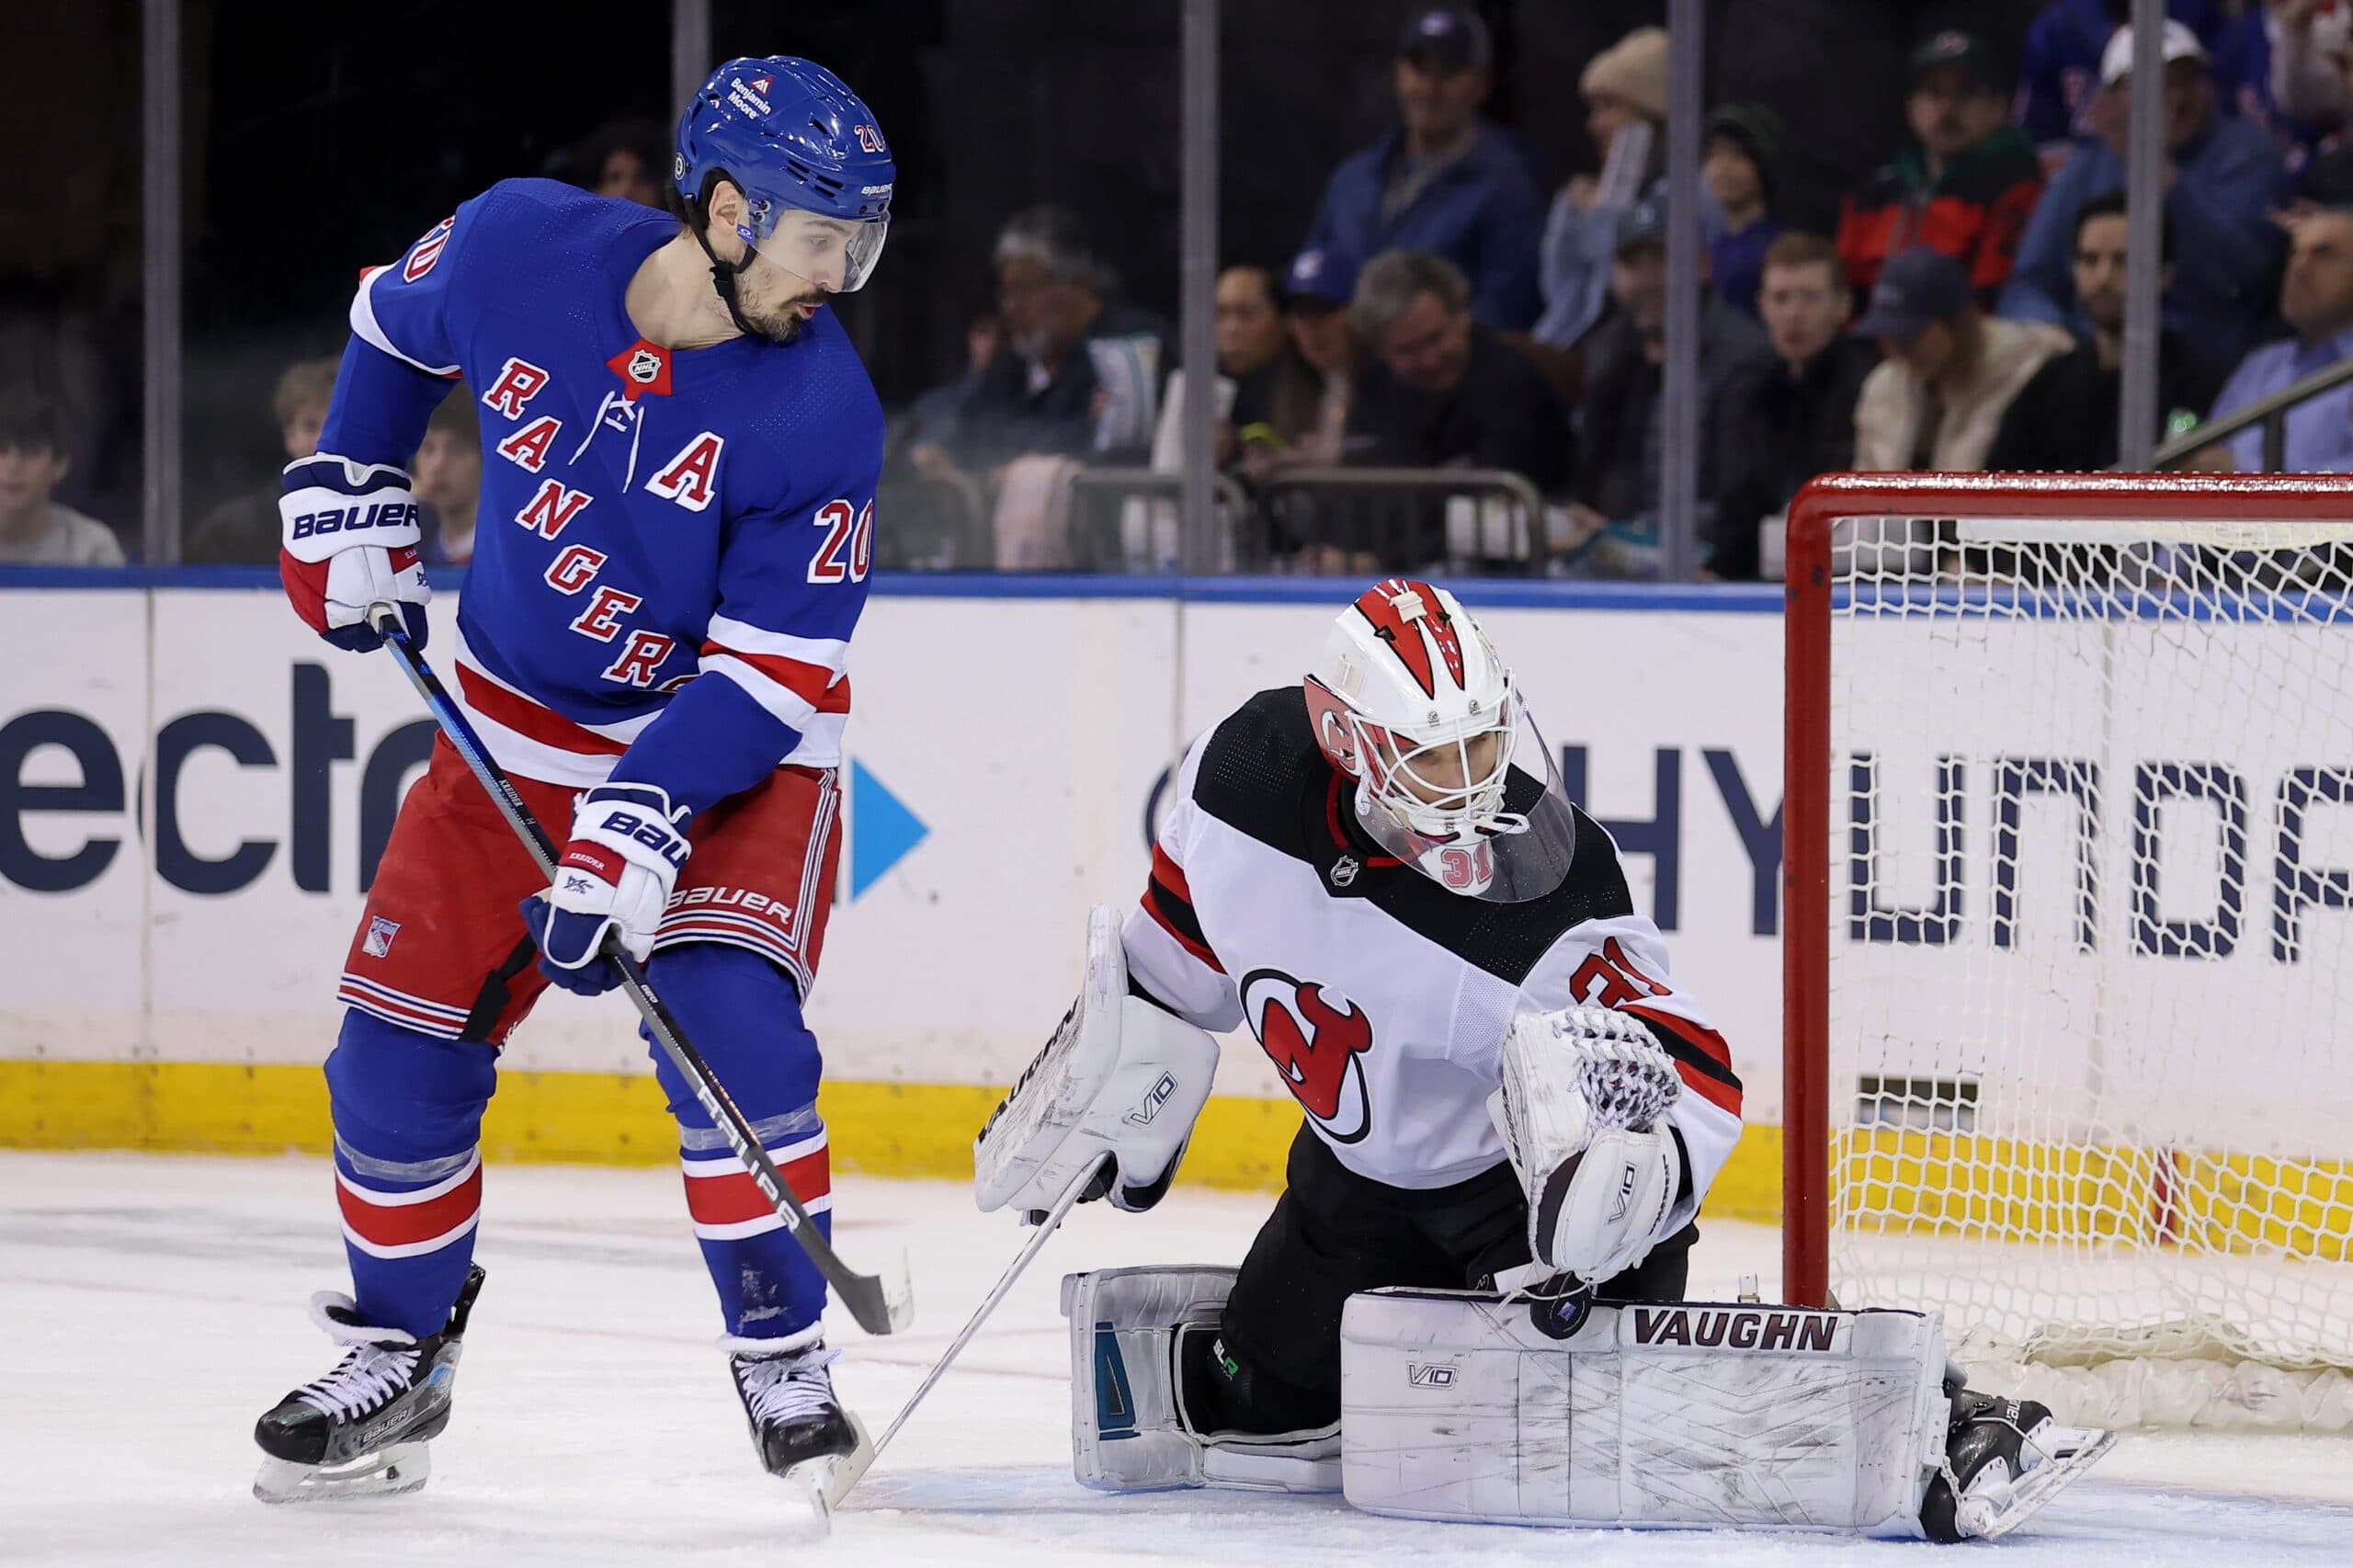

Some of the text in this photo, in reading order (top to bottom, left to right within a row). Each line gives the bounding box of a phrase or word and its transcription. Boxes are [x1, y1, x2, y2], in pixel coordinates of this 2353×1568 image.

[727, 91, 758, 119] Moore
[731, 77, 771, 115] Benjamin
[645, 431, 725, 512] A
[292, 504, 420, 540] BAUER
[807, 498, 873, 584] 20
[499, 778, 523, 807] KREIDER
[569, 852, 606, 870] KREIDER
[1440, 838, 1494, 888] 31
[668, 887, 792, 925] BAUER
[1634, 1308, 1838, 1351] VAUGHN
